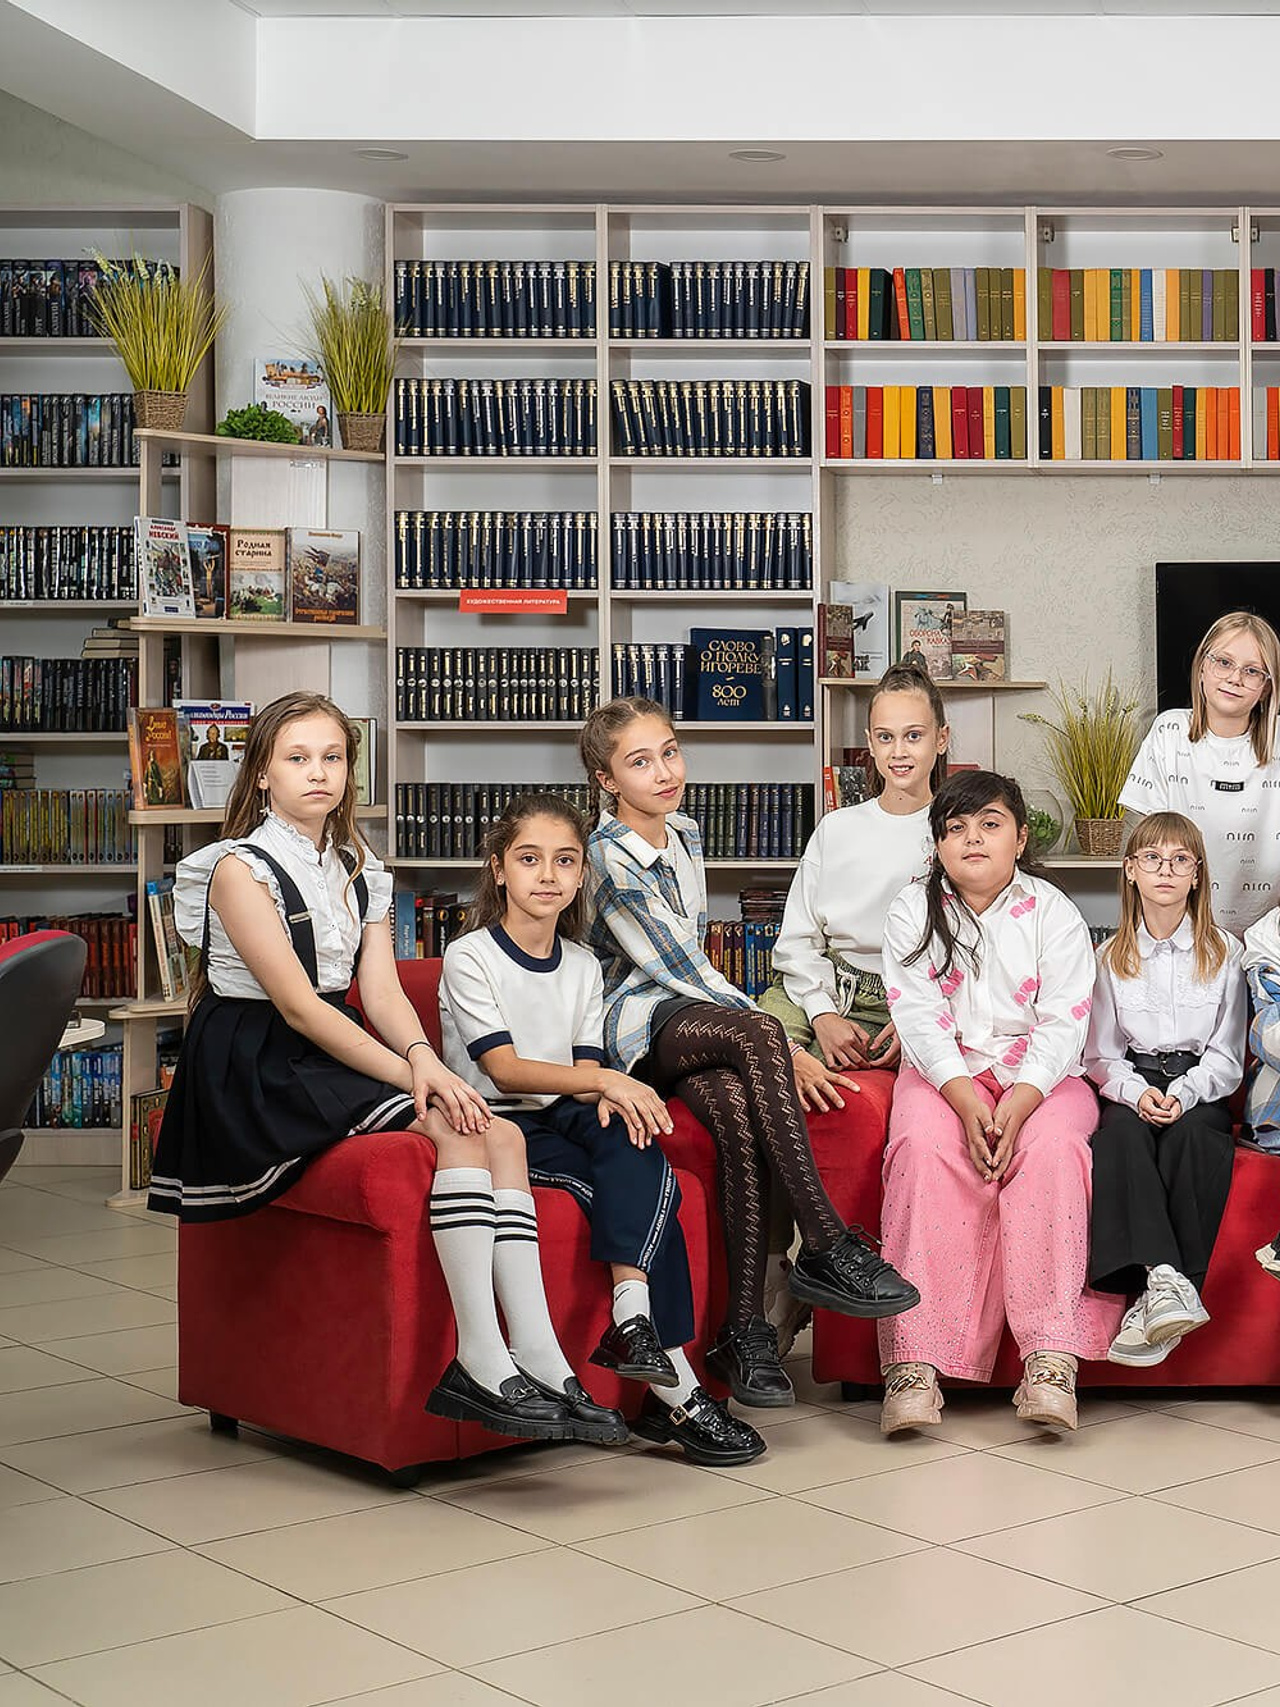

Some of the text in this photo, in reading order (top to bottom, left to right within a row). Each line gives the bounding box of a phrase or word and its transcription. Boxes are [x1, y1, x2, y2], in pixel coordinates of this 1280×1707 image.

[273, 400, 316, 409] РОССИИ
[148, 530, 180, 539] НЕВСКИЙ
[709, 640, 755, 652] СЛОВО
[701, 650, 760, 664] О ПОЛКУ
[700, 661, 762, 674] ИГОРЕВЕ
[712, 684, 747, 699] 800
[717, 698, 740, 706] лет
